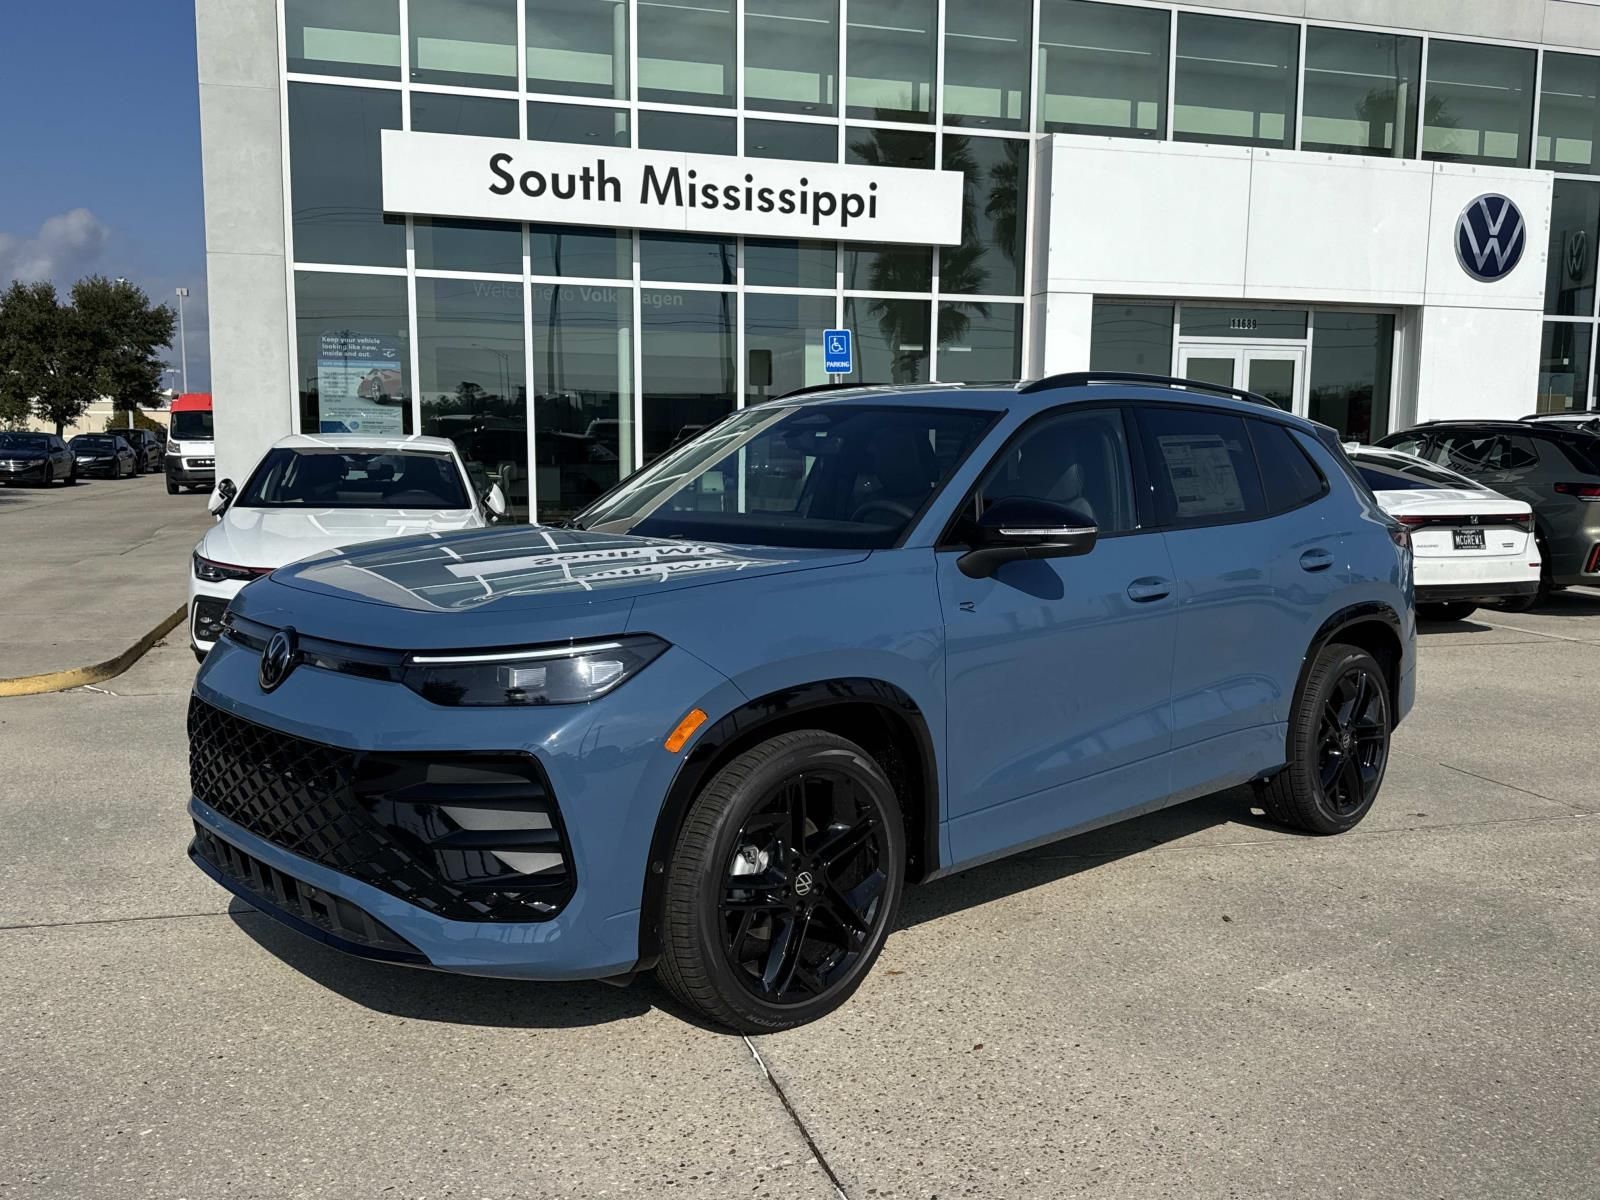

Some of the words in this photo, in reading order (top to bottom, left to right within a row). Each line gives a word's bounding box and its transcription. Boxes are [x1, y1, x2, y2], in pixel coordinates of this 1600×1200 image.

[488, 152, 622, 202] South
[640, 164, 878, 228] Mississippi
[579, 287, 683, 308] Volkagen
[1231, 318, 1257, 329] 11689
[1455, 534, 1483, 546] MCGREW1
